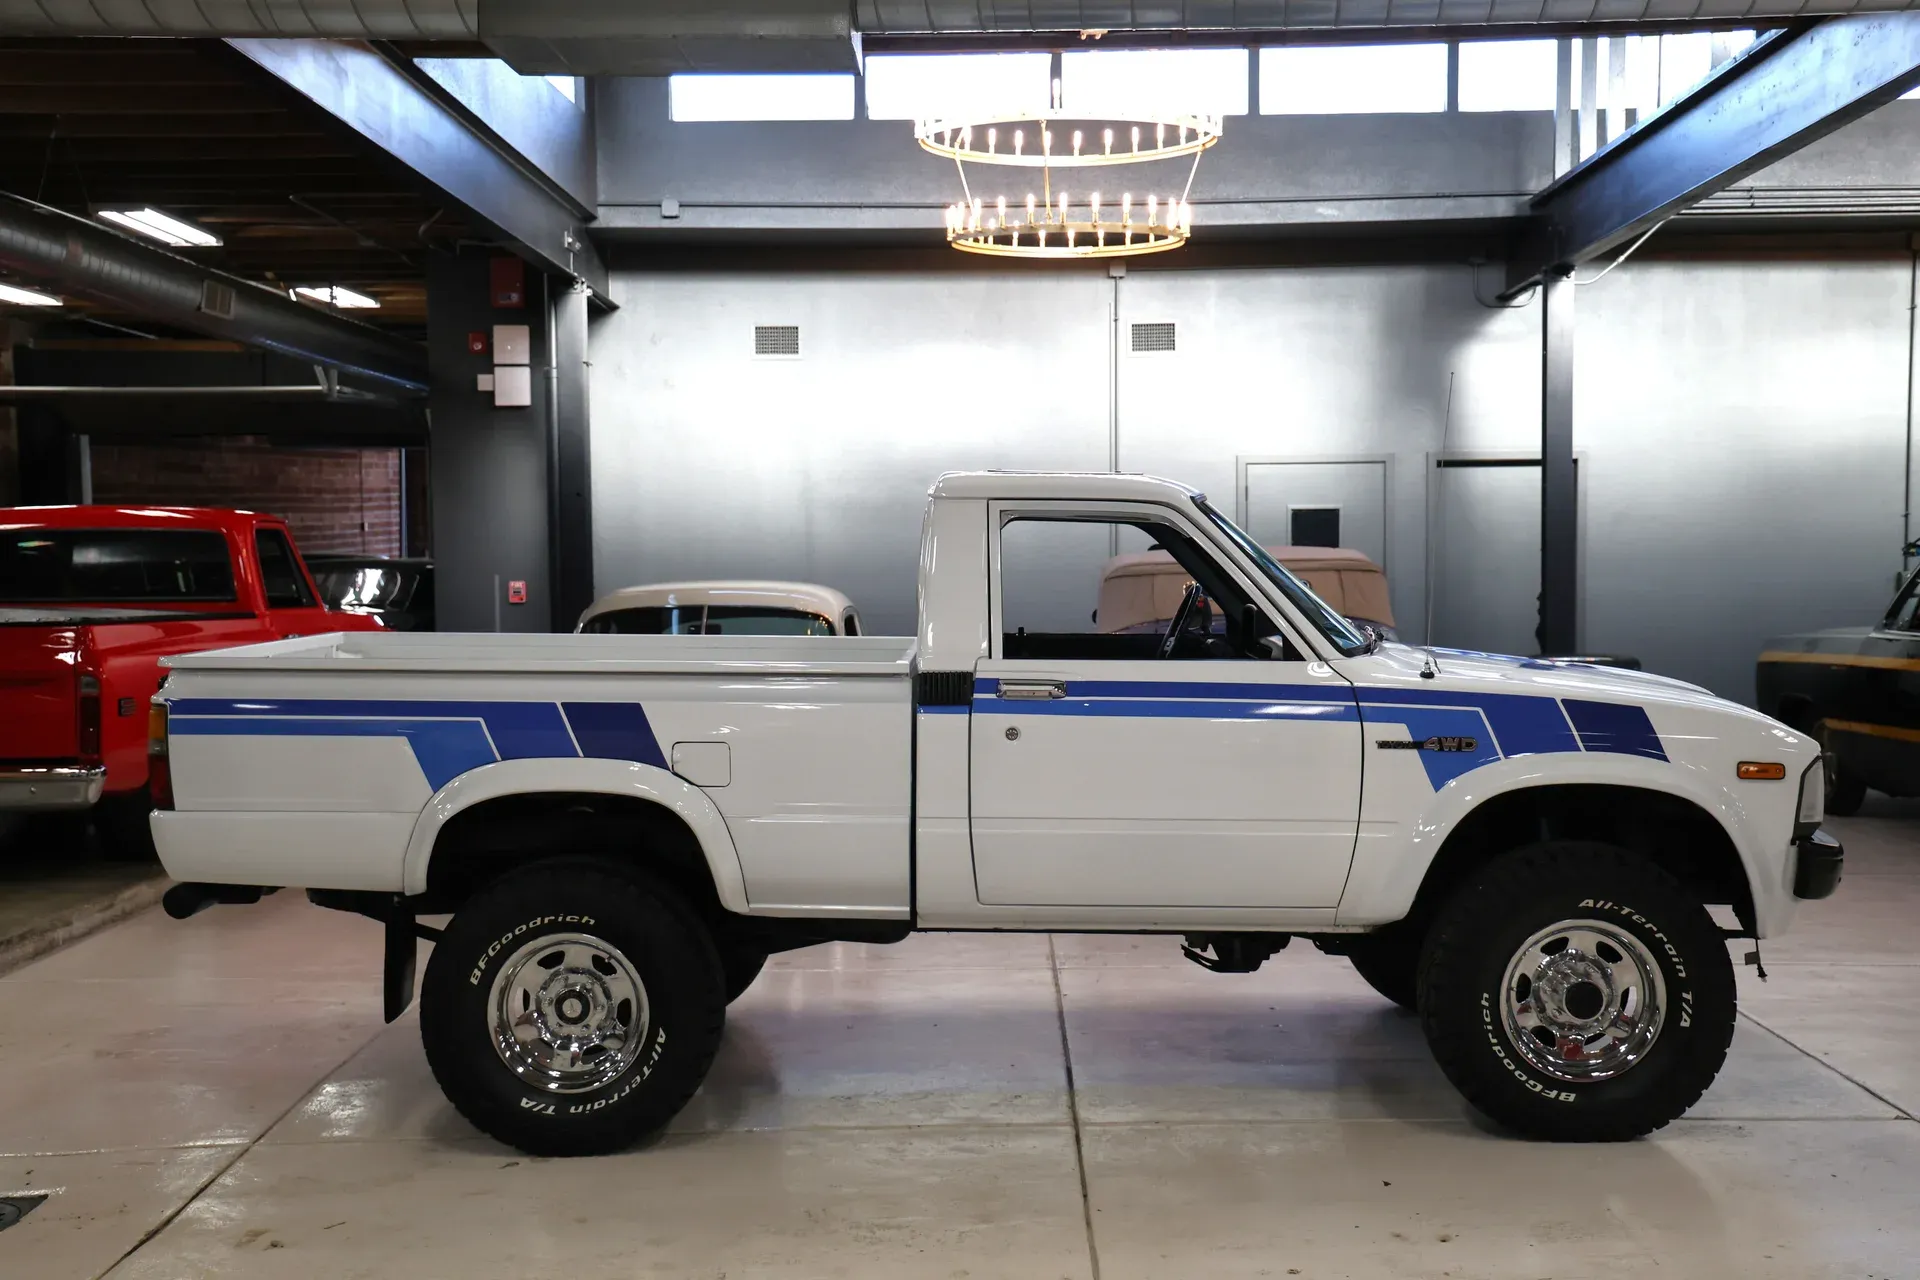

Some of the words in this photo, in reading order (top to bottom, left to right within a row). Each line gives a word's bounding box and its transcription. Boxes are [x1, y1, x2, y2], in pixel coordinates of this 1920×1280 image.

[1423, 736, 1477, 752] 4WD
[469, 913, 597, 986] BFGoodrich
[1578, 898, 1687, 978] All-Terrain
[1681, 990, 1694, 1029] T/A
[569, 1026, 667, 1115] All-Terrain
[1480, 992, 1578, 1102] BFGoodrich
[519, 1096, 556, 1116] T/A
